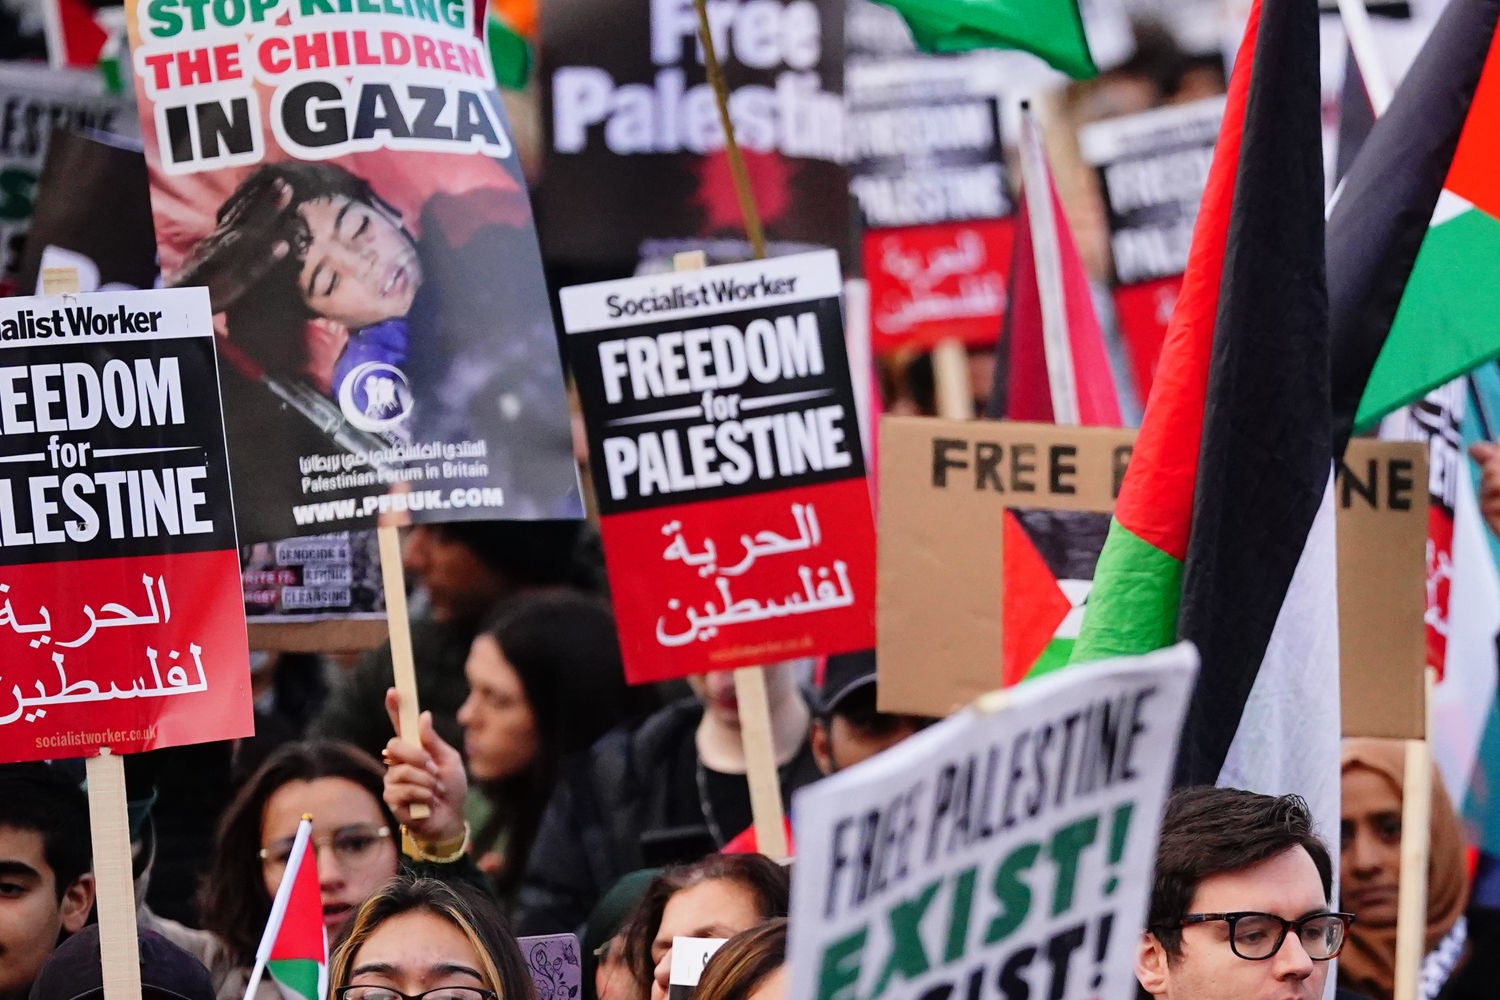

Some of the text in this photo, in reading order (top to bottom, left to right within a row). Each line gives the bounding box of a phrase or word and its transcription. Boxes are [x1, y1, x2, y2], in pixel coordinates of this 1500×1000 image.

[144, 30, 486, 91] THE CHILDREN
[164, 97, 255, 164] IN
[281, 80, 503, 149] GAZA
[598, 311, 825, 405] FREEDOM
[701, 388, 742, 423] for
[46, 433, 92, 469] for
[302, 471, 376, 494] Palestinian
[426, 463, 439, 478] in
[443, 460, 489, 479] Britain
[602, 403, 853, 501] PALESTINE
[931, 437, 1078, 495] FREE
[293, 487, 505, 526] WWW.PFBUK.COM
[660, 502, 822, 578] الحرية
[655, 559, 856, 647] لفلسطين
[35, 724, 158, 748] socialistworker.co.uk
[826, 685, 1158, 919] FREE PALESTINE
